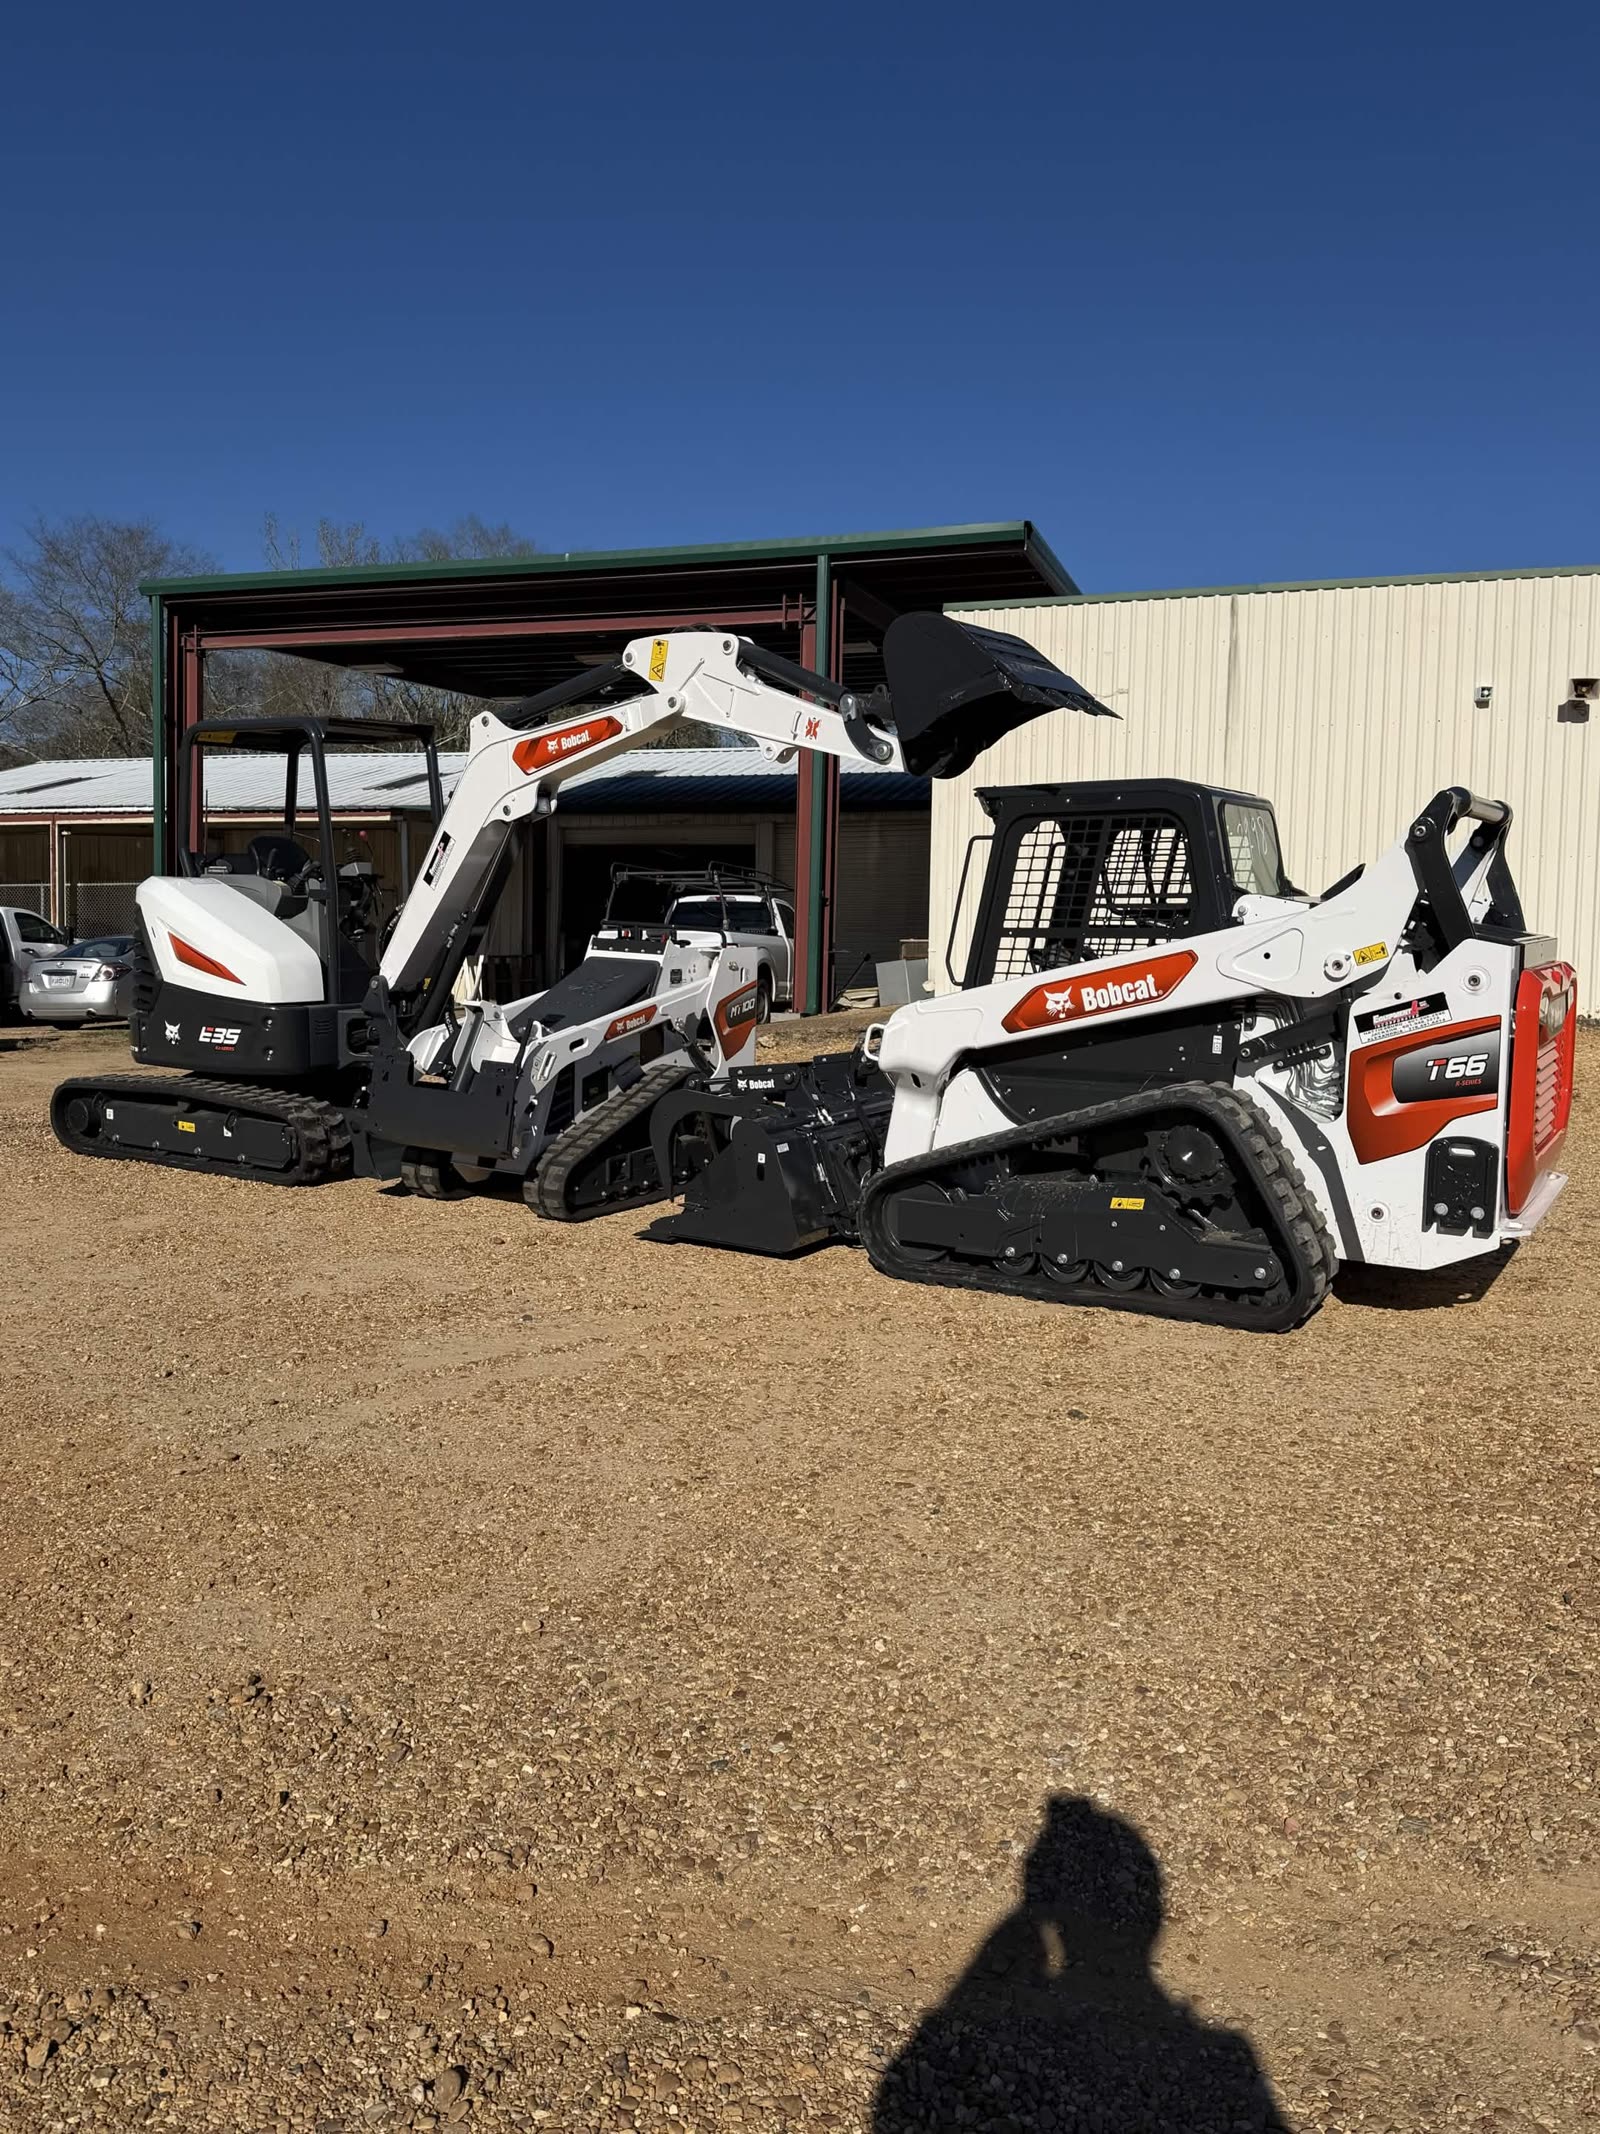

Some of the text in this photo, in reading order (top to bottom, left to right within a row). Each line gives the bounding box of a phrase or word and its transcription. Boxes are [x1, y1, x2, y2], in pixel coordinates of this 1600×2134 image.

[561, 729, 590, 750] Bobcat
[1080, 973, 1158, 1012] Bobcat
[626, 1014, 647, 1030] Bobcat
[198, 1026, 242, 1045] E35
[1427, 1053, 1489, 1081] T66
[748, 1078, 775, 1090] Bobcat
